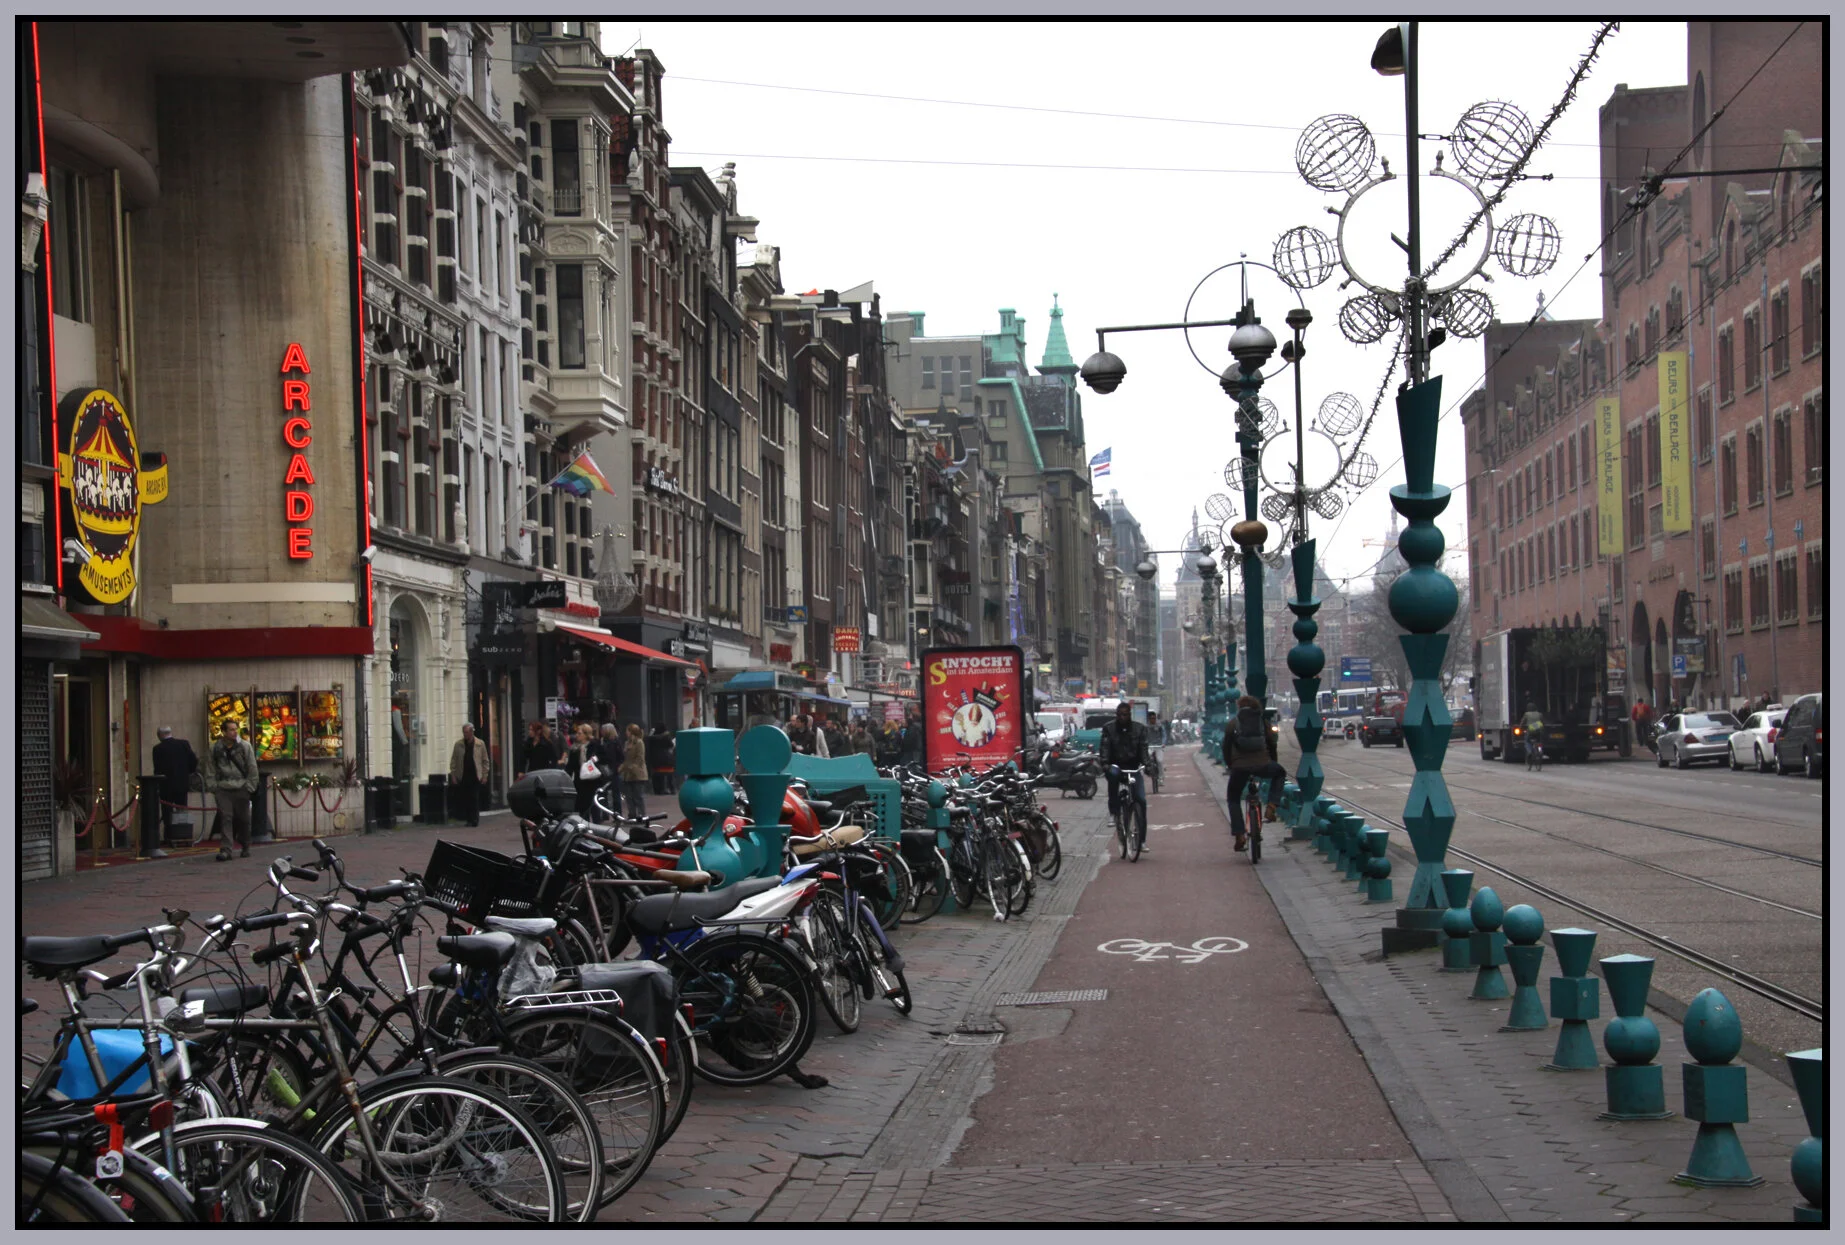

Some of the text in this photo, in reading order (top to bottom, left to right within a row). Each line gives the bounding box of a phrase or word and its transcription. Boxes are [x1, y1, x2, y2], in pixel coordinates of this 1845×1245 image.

[1668, 360, 1677, 394] BEURS
[282, 343, 314, 559] ARCADE
[1669, 414, 1680, 462] BERLAGE
[83, 563, 132, 595] AMUSEMENTS
[942, 656, 1013, 668] INTOCHT
[968, 667, 1013, 675] Amsterdam
[1674, 656, 1683, 667] P
